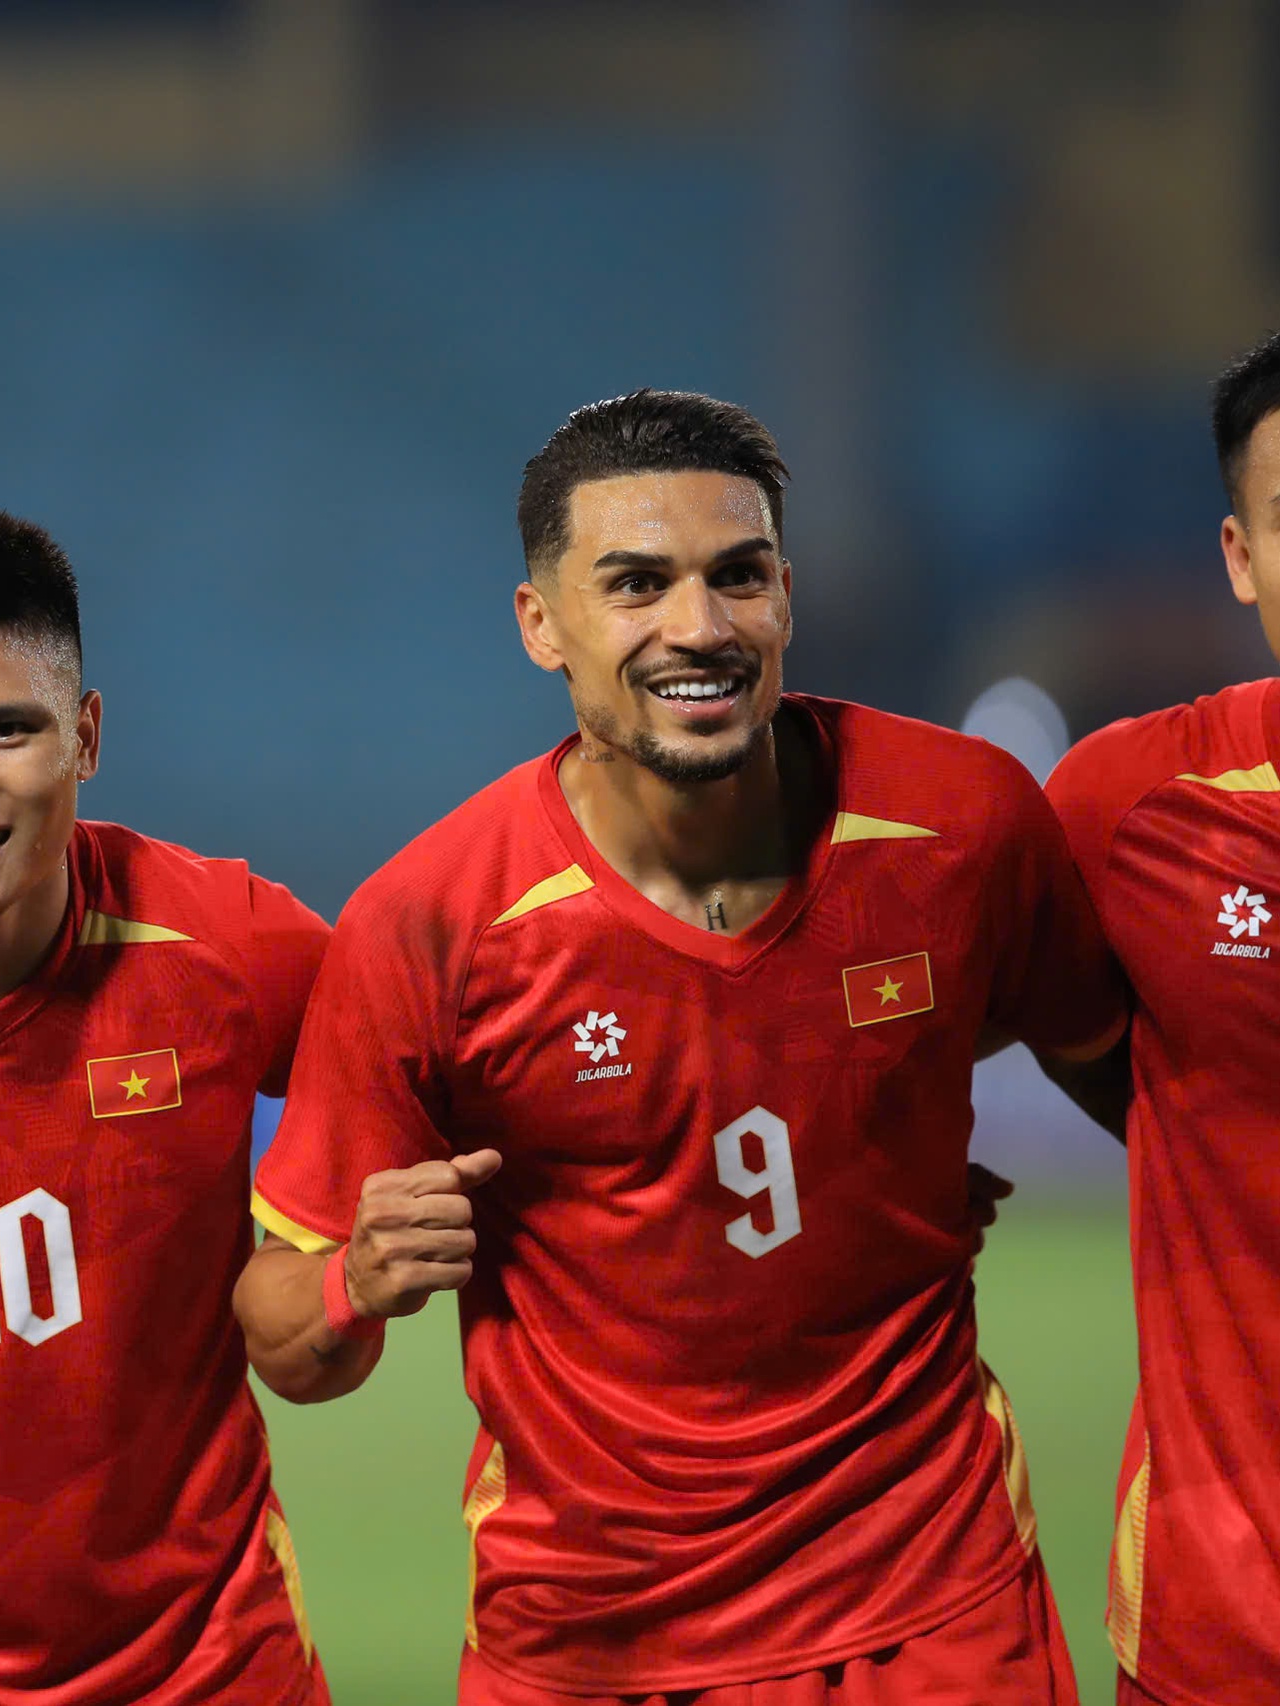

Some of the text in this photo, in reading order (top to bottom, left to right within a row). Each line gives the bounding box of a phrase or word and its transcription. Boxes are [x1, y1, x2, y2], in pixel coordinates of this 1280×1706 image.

[1210, 941, 1271, 959] JOGARBOLA
[574, 1062, 632, 1083] JOGARBOLA
[713, 1105, 802, 1259] 9
